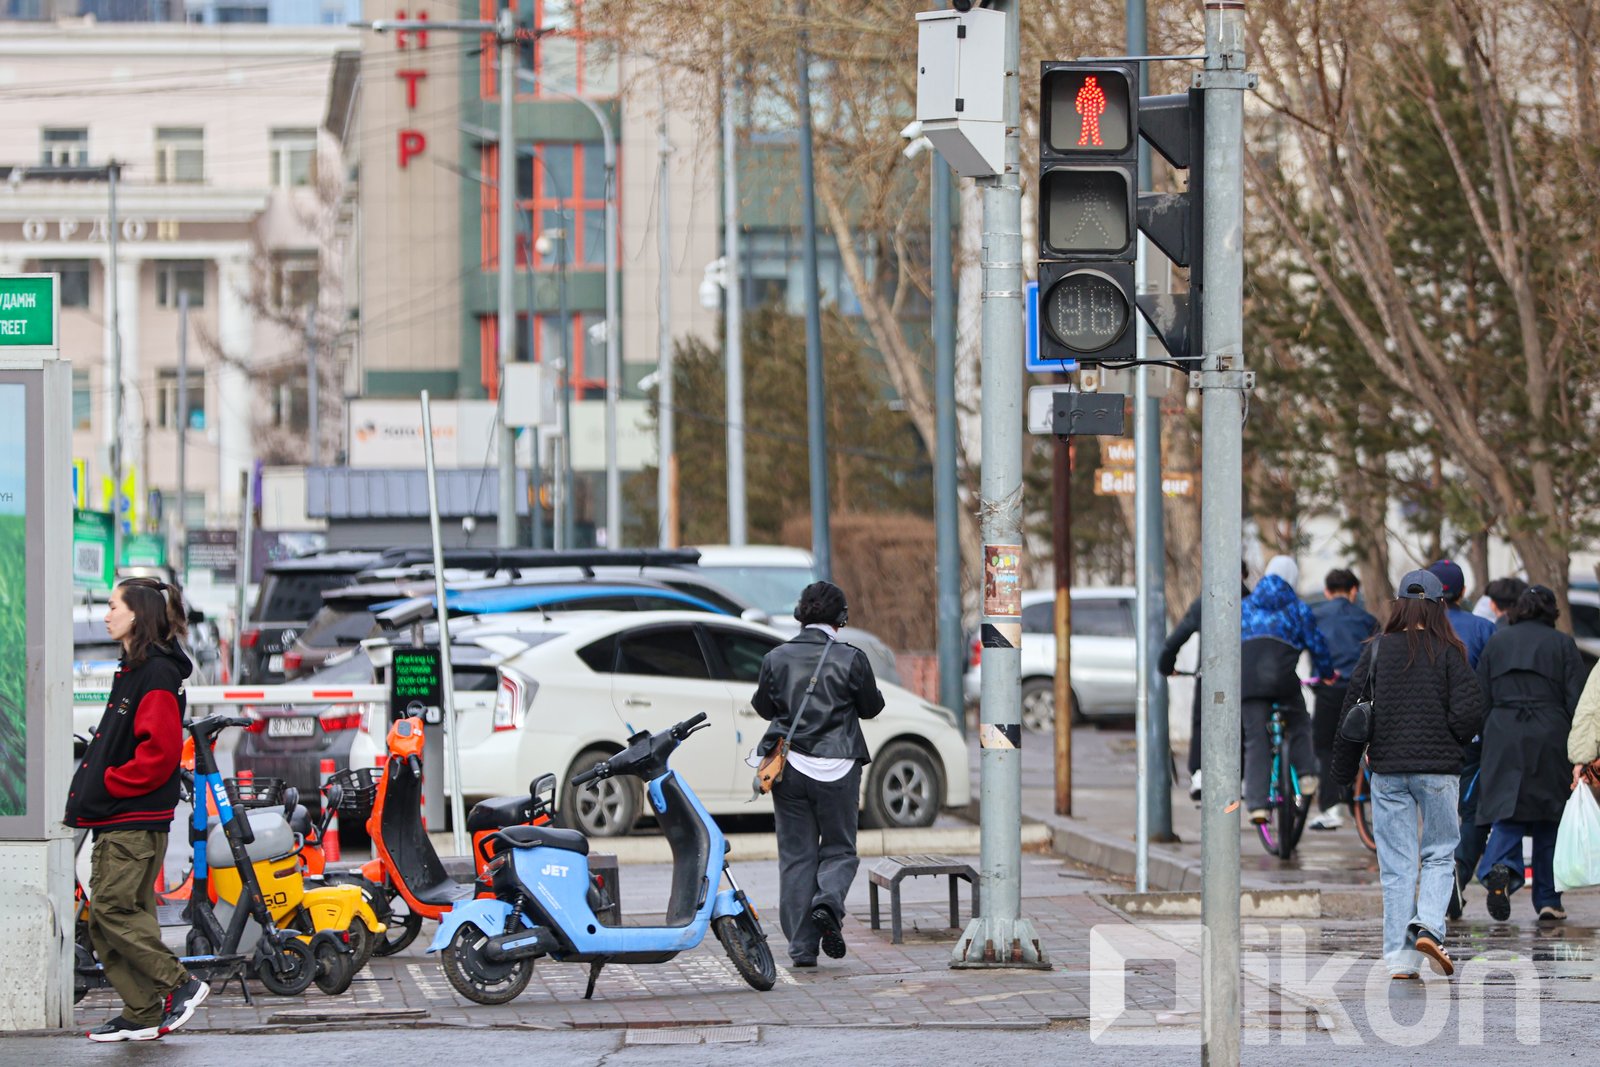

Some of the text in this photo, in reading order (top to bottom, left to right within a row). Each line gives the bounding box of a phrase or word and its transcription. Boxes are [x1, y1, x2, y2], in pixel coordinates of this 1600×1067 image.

[22, 217, 180, 242] ОРДОН
[0, 320, 28, 334] REET
[214, 783, 231, 807] JET
[541, 864, 569, 877] JET
